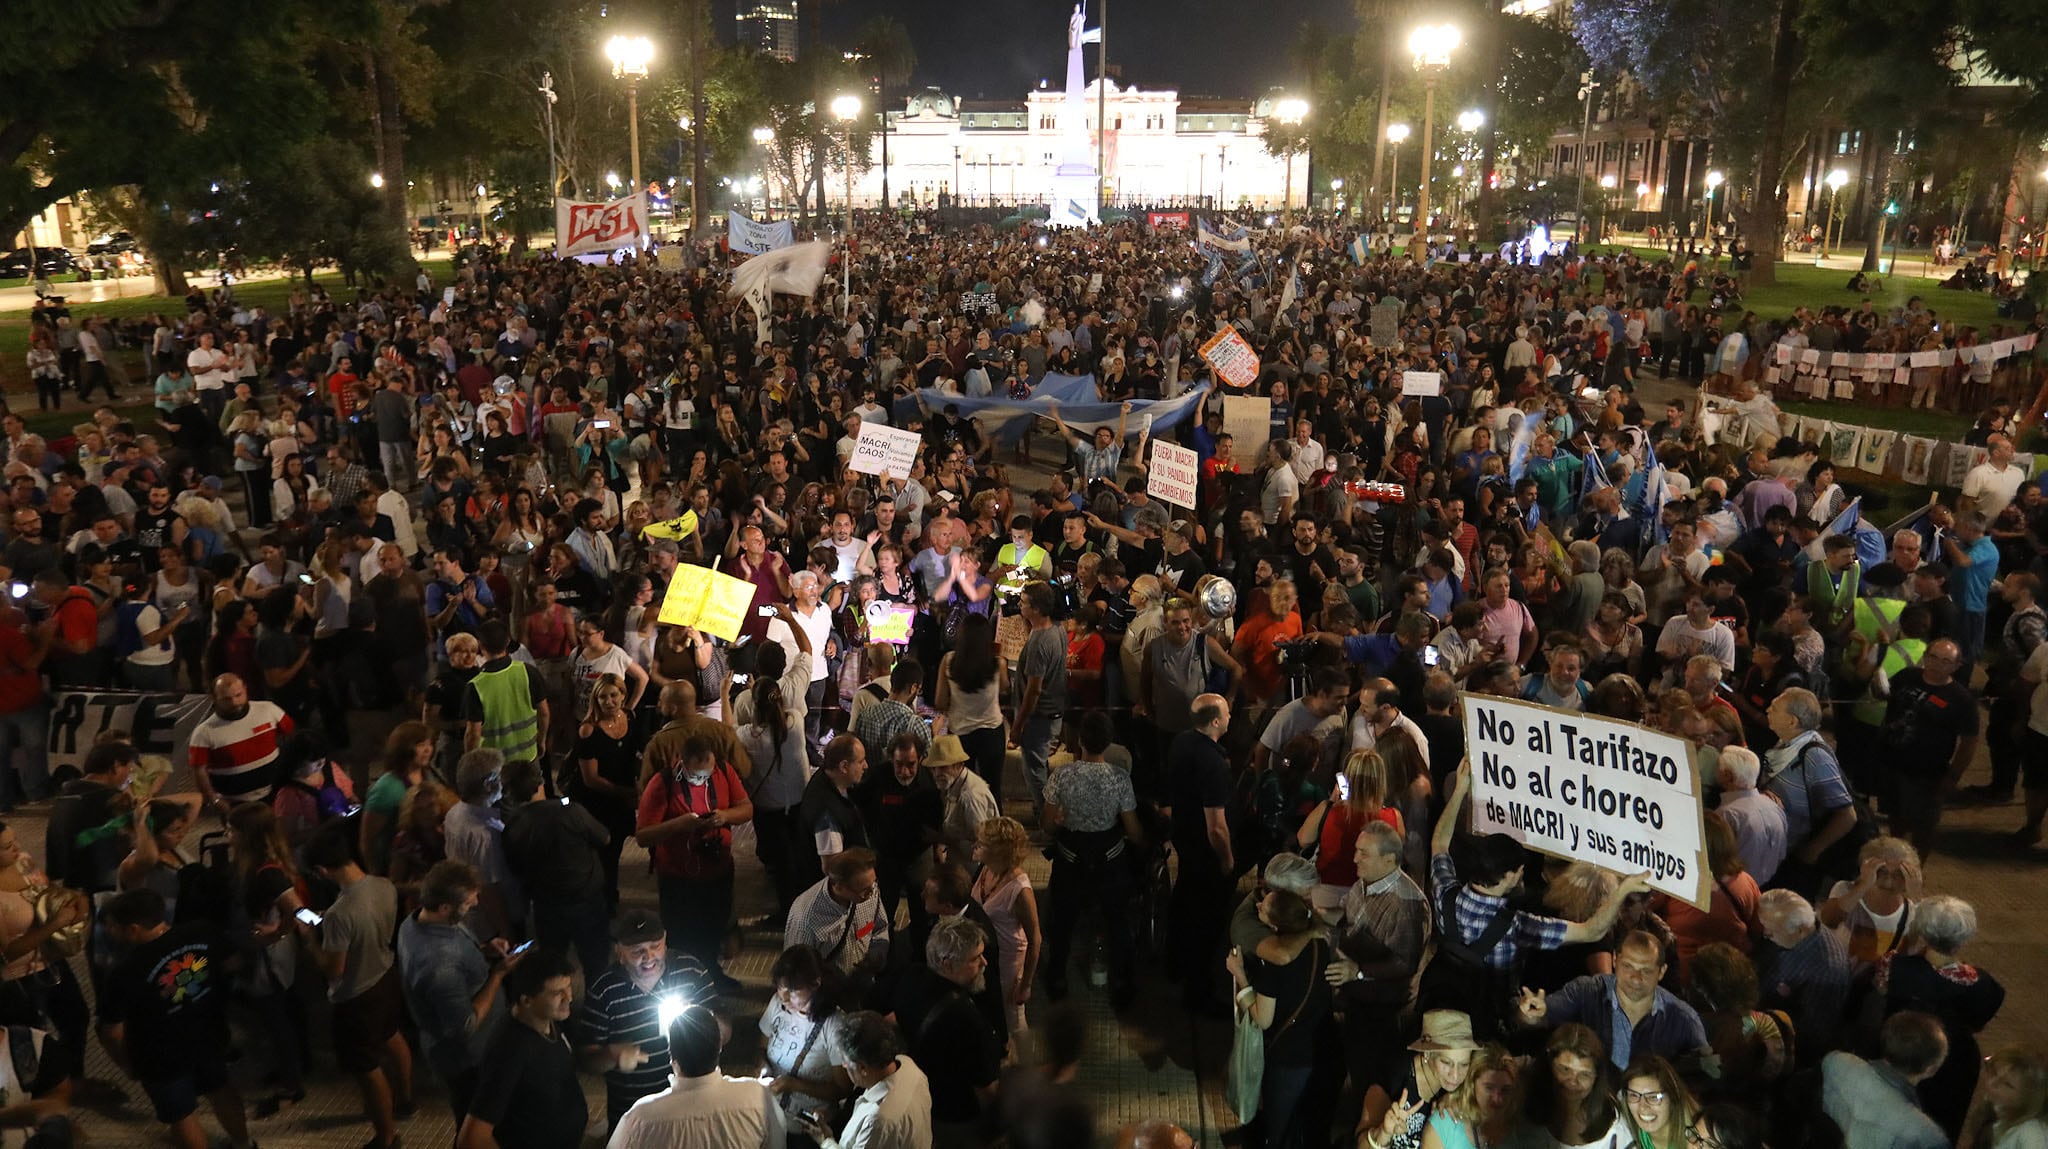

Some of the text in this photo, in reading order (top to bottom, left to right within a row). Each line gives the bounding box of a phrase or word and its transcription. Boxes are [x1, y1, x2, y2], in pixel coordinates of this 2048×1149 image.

[573, 198, 638, 238] MST
[744, 239, 771, 252] OESTE
[749, 231, 767, 239] ZONA
[858, 446, 885, 459] CAOS
[860, 436, 891, 450] MACRI
[1154, 444, 1172, 461] FUERA
[1175, 450, 1195, 468] MACRI
[1151, 461, 1195, 486] Y SU PANDILLA
[1149, 478, 1193, 504] DE CAMBIEMOS
[1477, 707, 1677, 785] No al Tarifazo
[1482, 751, 1663, 830] No al choreo
[1486, 797, 1685, 881] de MACRI y sus amigos
